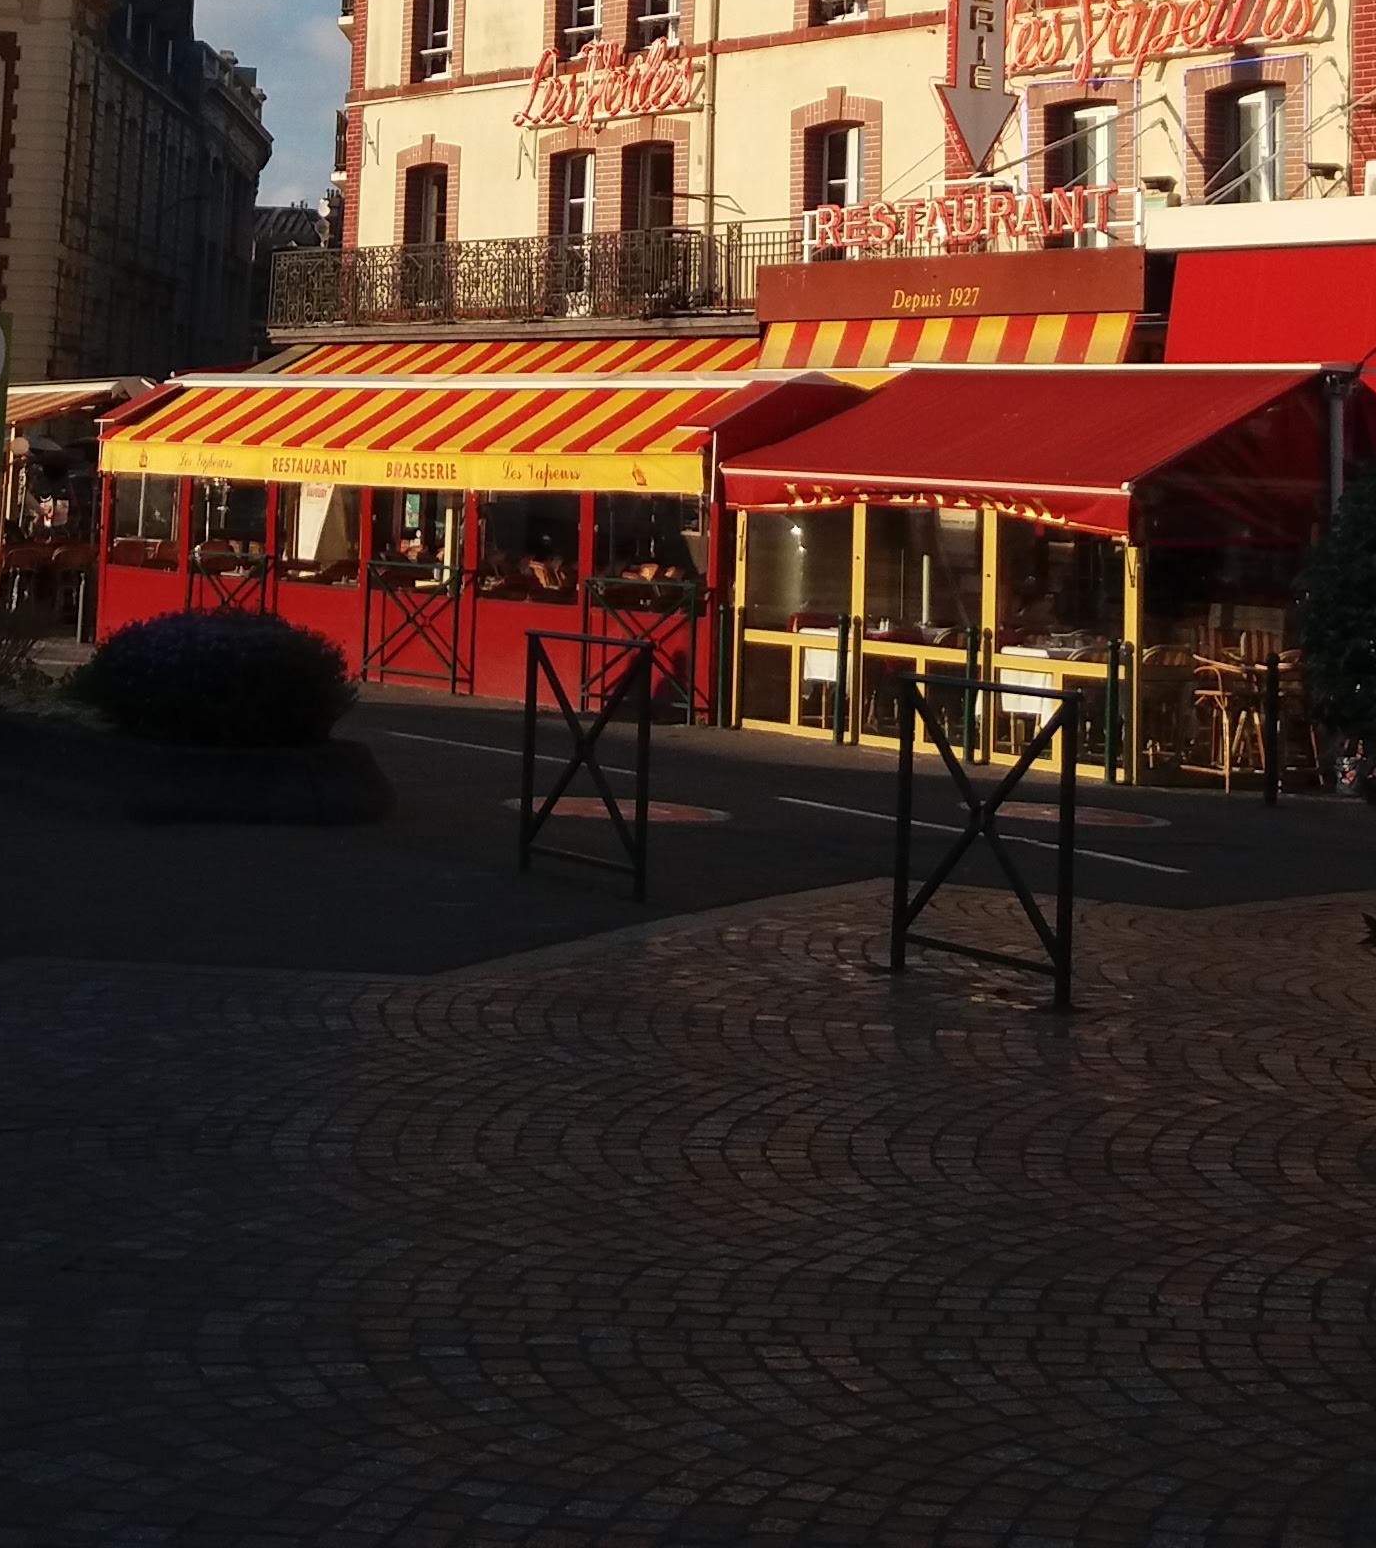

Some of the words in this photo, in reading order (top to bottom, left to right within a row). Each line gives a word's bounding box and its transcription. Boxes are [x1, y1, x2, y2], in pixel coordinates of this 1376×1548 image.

[815, 183, 1119, 248] RESTAURANT
[891, 289, 942, 313] Depuis
[947, 287, 980, 307] 1927
[178, 451, 193, 466] Les
[272, 456, 348, 476] RESTAURANT
[386, 461, 458, 480] BRASSERIE
[502, 463, 523, 481] Les
[527, 463, 581, 488] Vapeurs
